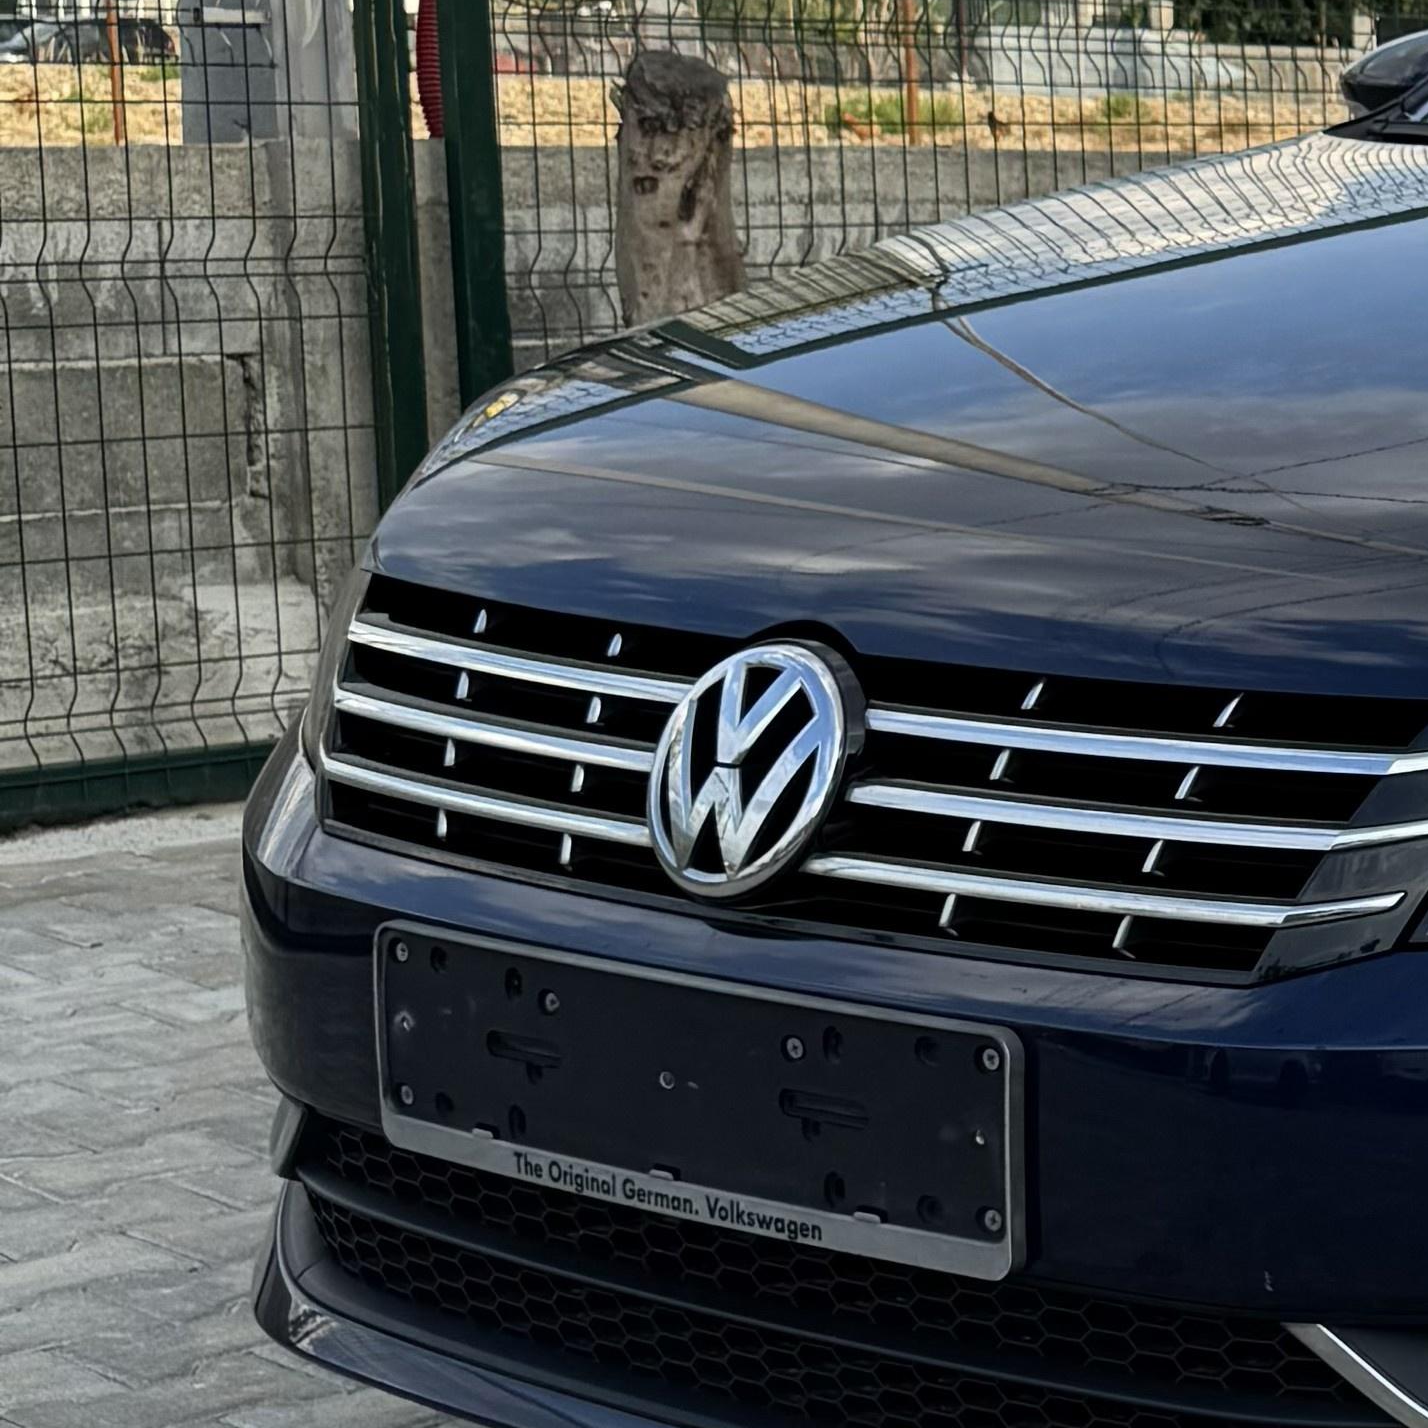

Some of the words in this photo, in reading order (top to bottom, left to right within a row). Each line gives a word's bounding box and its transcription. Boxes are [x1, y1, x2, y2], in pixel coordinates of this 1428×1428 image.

[653, 647, 842, 887] VW
[514, 1151, 543, 1180] The
[549, 1160, 616, 1194] Original
[622, 1178, 699, 1216] German.
[705, 1194, 823, 1242] Volkswagen
